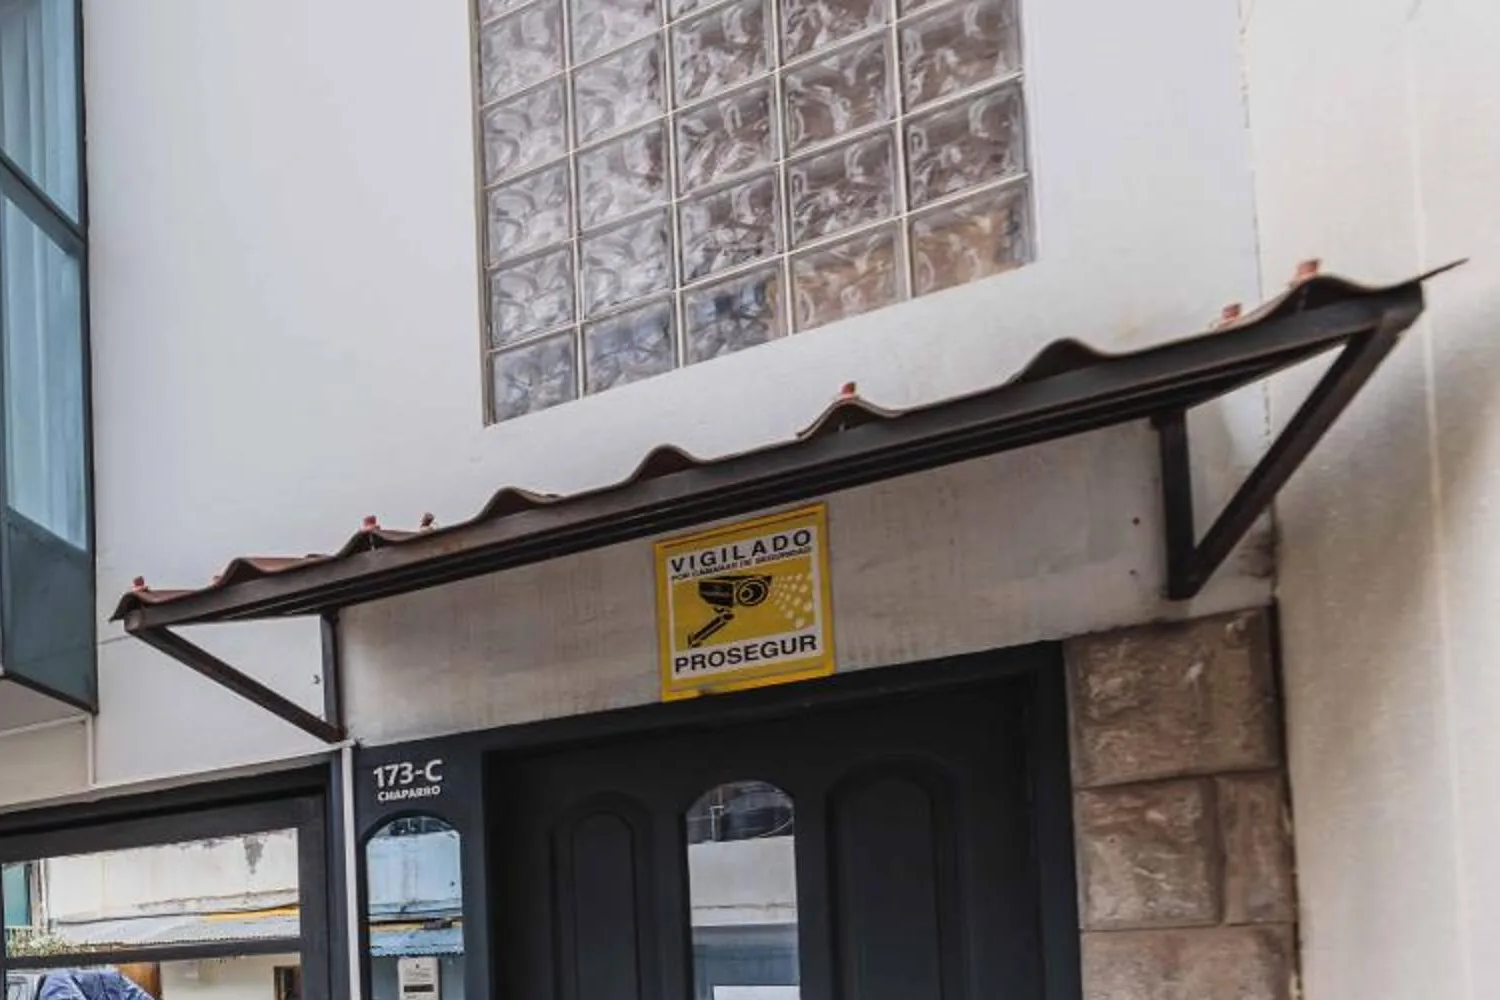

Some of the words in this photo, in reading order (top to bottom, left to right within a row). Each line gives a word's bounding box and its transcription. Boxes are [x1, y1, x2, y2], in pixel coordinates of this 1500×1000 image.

[671, 529, 812, 574] VIGILADO
[675, 634, 818, 674] PROSEGUR
[373, 759, 443, 788] 173-C
